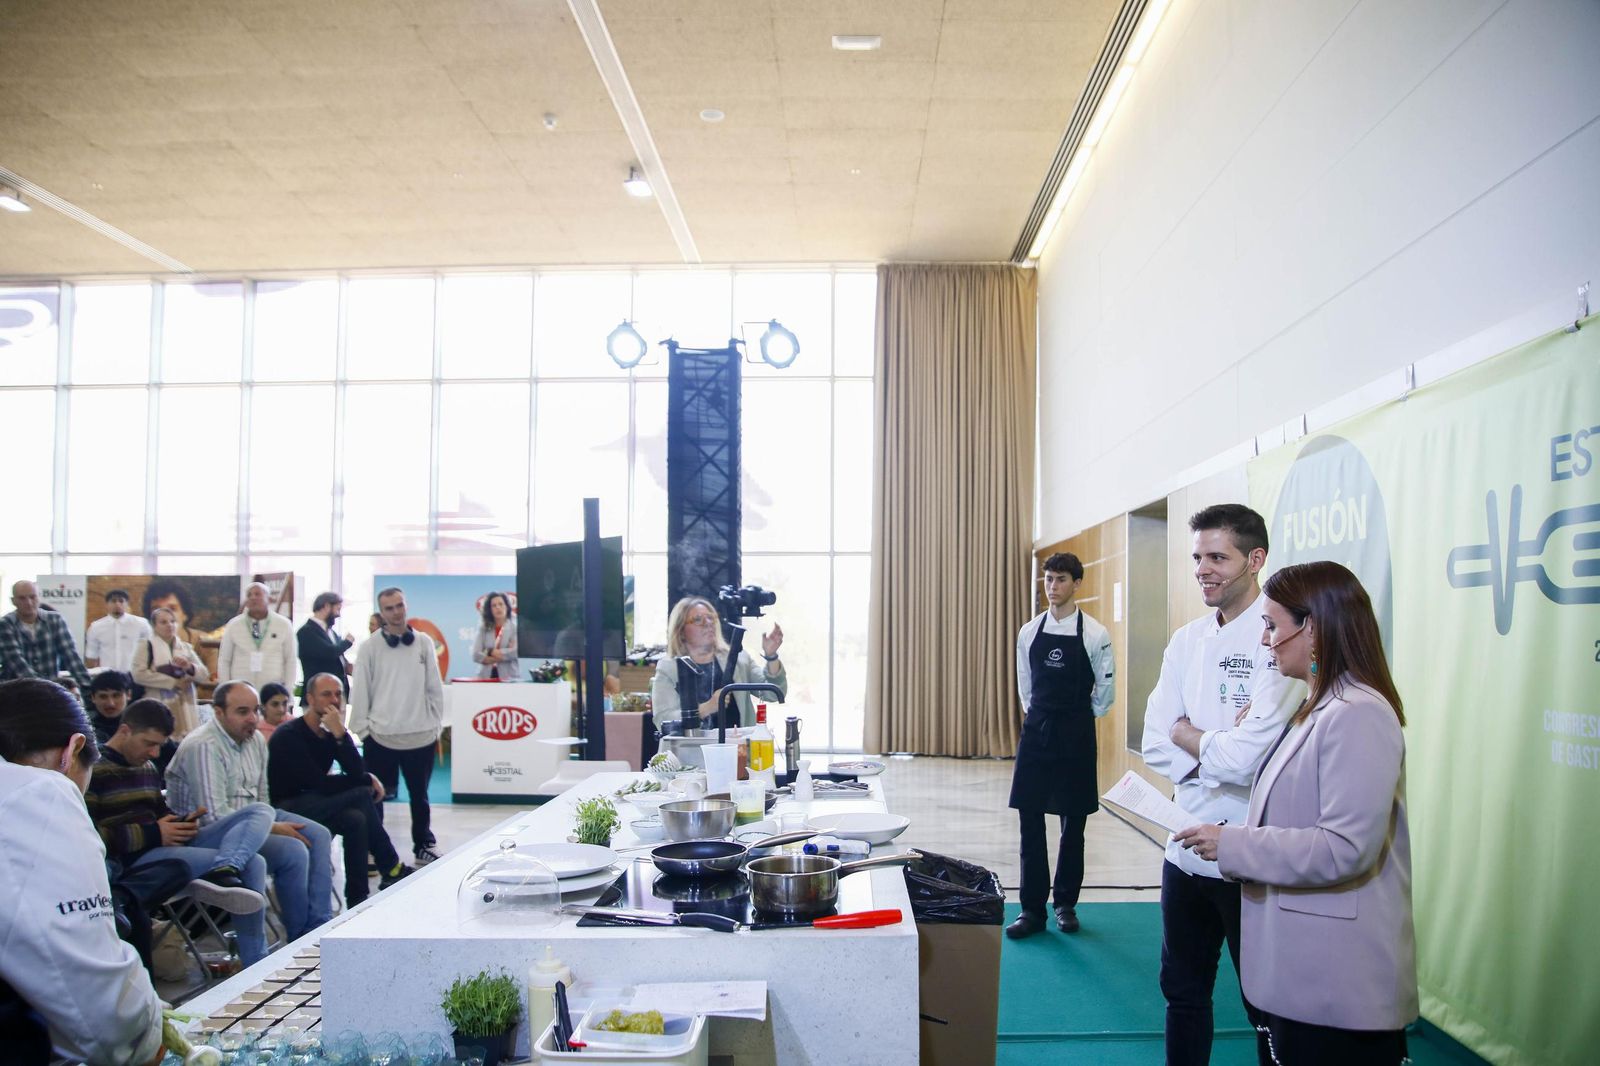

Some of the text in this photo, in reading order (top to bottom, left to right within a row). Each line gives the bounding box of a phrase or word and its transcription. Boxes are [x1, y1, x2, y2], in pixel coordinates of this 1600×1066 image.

[1283, 488, 1367, 553] FUSIÓN
[42, 586, 83, 598] BOLLO
[475, 708, 535, 735] TROPS
